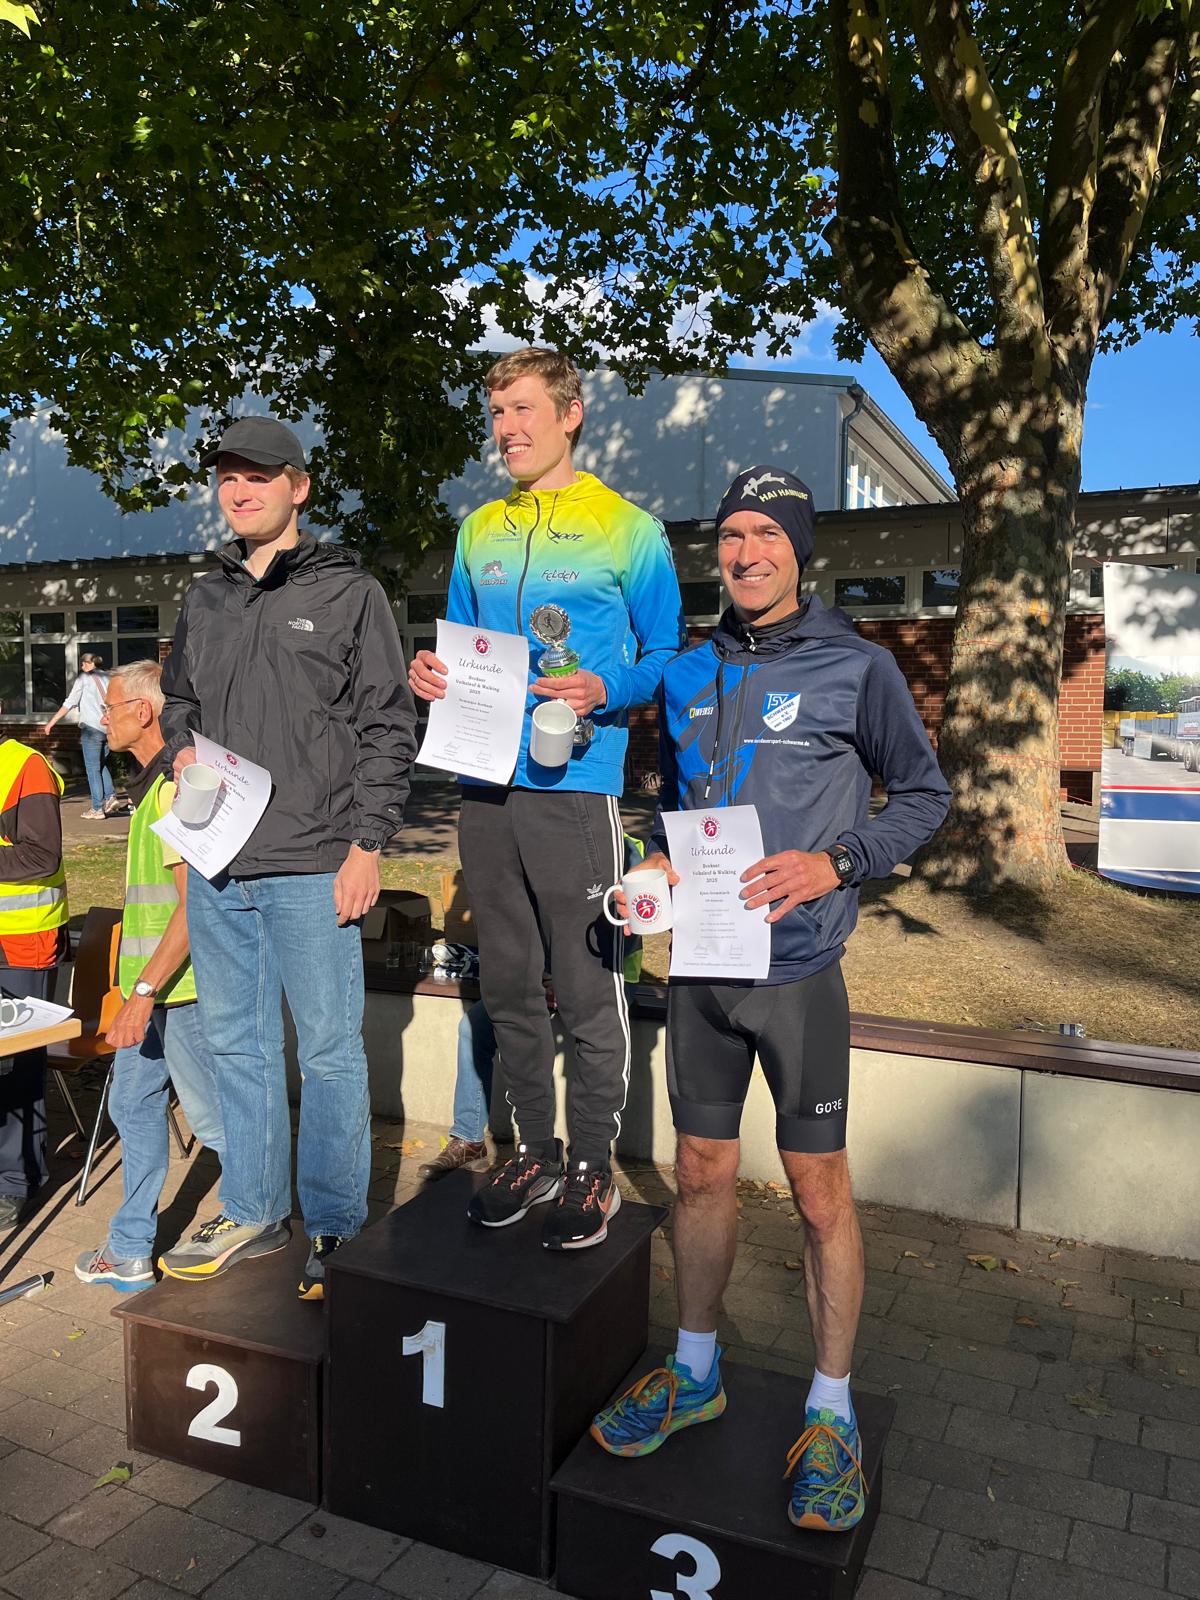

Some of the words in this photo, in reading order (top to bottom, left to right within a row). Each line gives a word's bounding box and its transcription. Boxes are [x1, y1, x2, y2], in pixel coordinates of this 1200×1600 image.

[759, 489, 778, 502] HAI
[458, 658, 503, 673] Urkunde
[766, 693, 789, 710] TSV
[690, 844, 737, 857] Urkunde
[815, 1098, 843, 1115] GORE
[402, 1320, 446, 1408] 1
[185, 1363, 241, 1447] 2
[649, 1533, 722, 1600] 3
